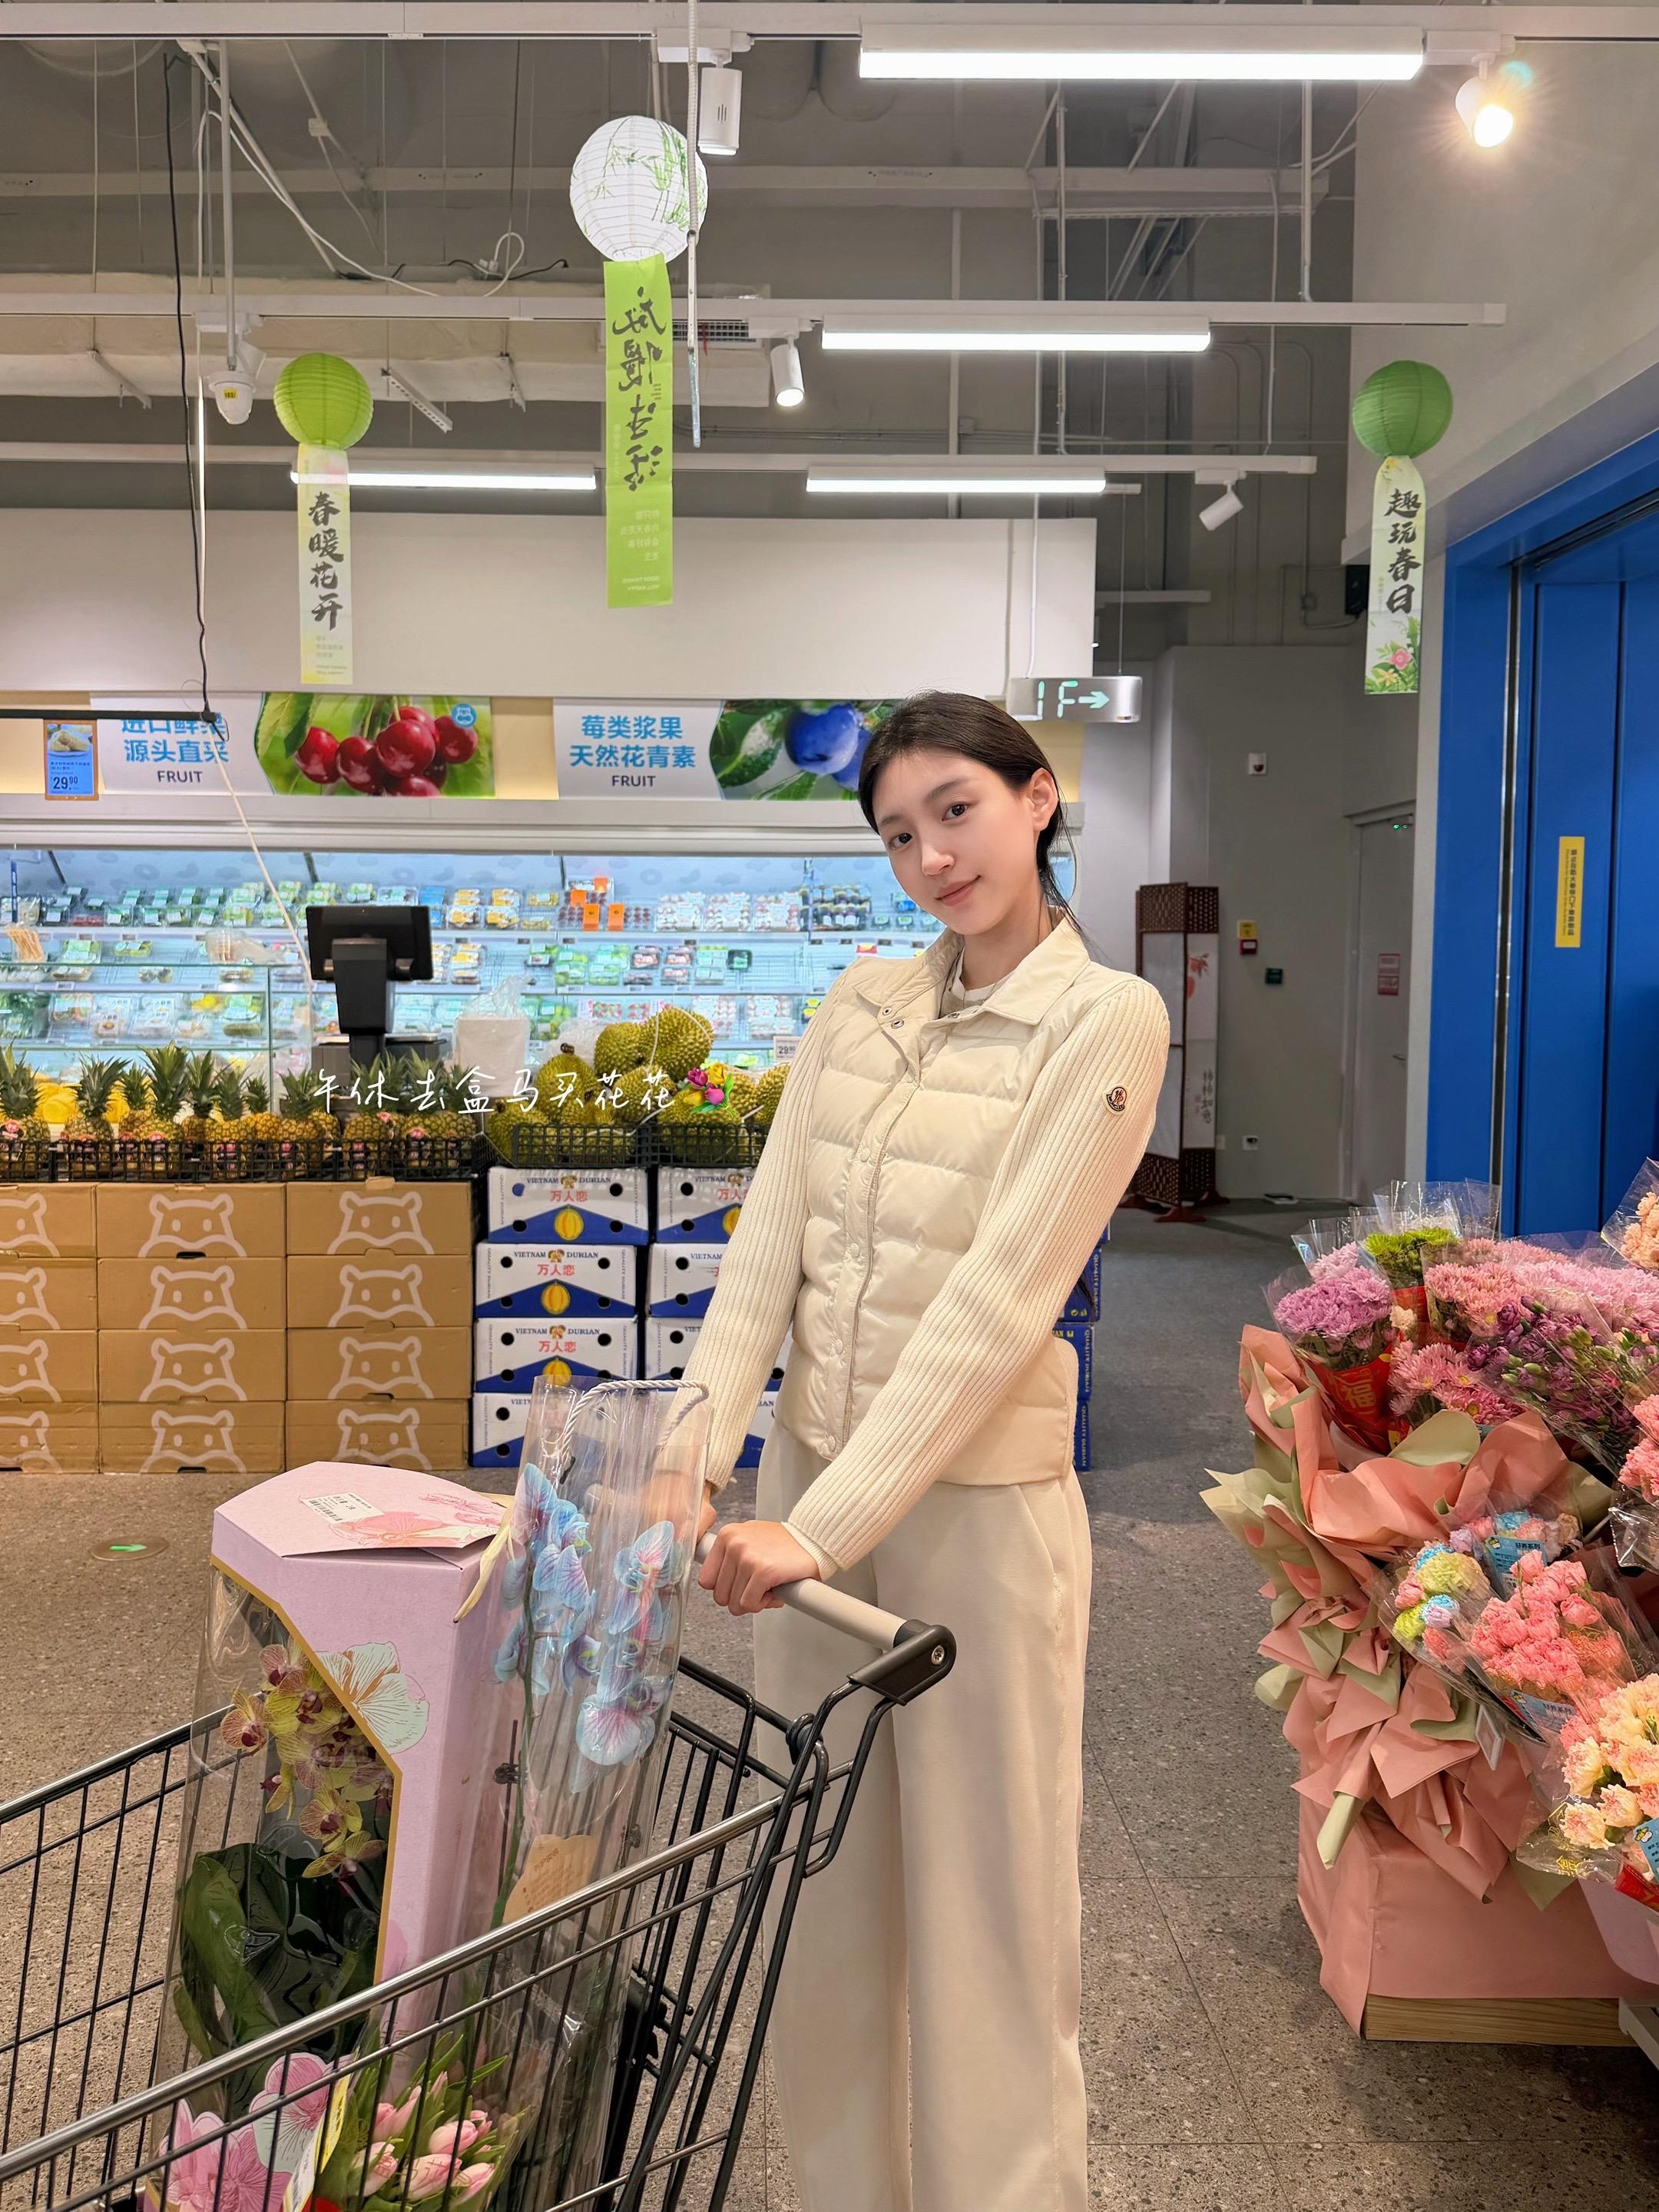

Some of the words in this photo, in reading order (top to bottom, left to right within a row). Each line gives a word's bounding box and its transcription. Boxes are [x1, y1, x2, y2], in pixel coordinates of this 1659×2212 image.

[308, 492, 344, 631] 春暖花开
[1384, 488, 1422, 614] 趣玩春日
[1037, 680, 1078, 718] 1F
[581, 714, 684, 740] 莓类浆果
[124, 740, 230, 763] 源头直采
[569, 744, 696, 769] 天然花青素
[157, 770, 203, 783] FRUIT
[611, 775, 656, 787] FRUIT
[550, 1190, 588, 1202] 万人恋
[538, 1264, 575, 1276] 万人恋
[538, 1340, 577, 1353] 万人恋
[1340, 1383, 1377, 1409] 福
